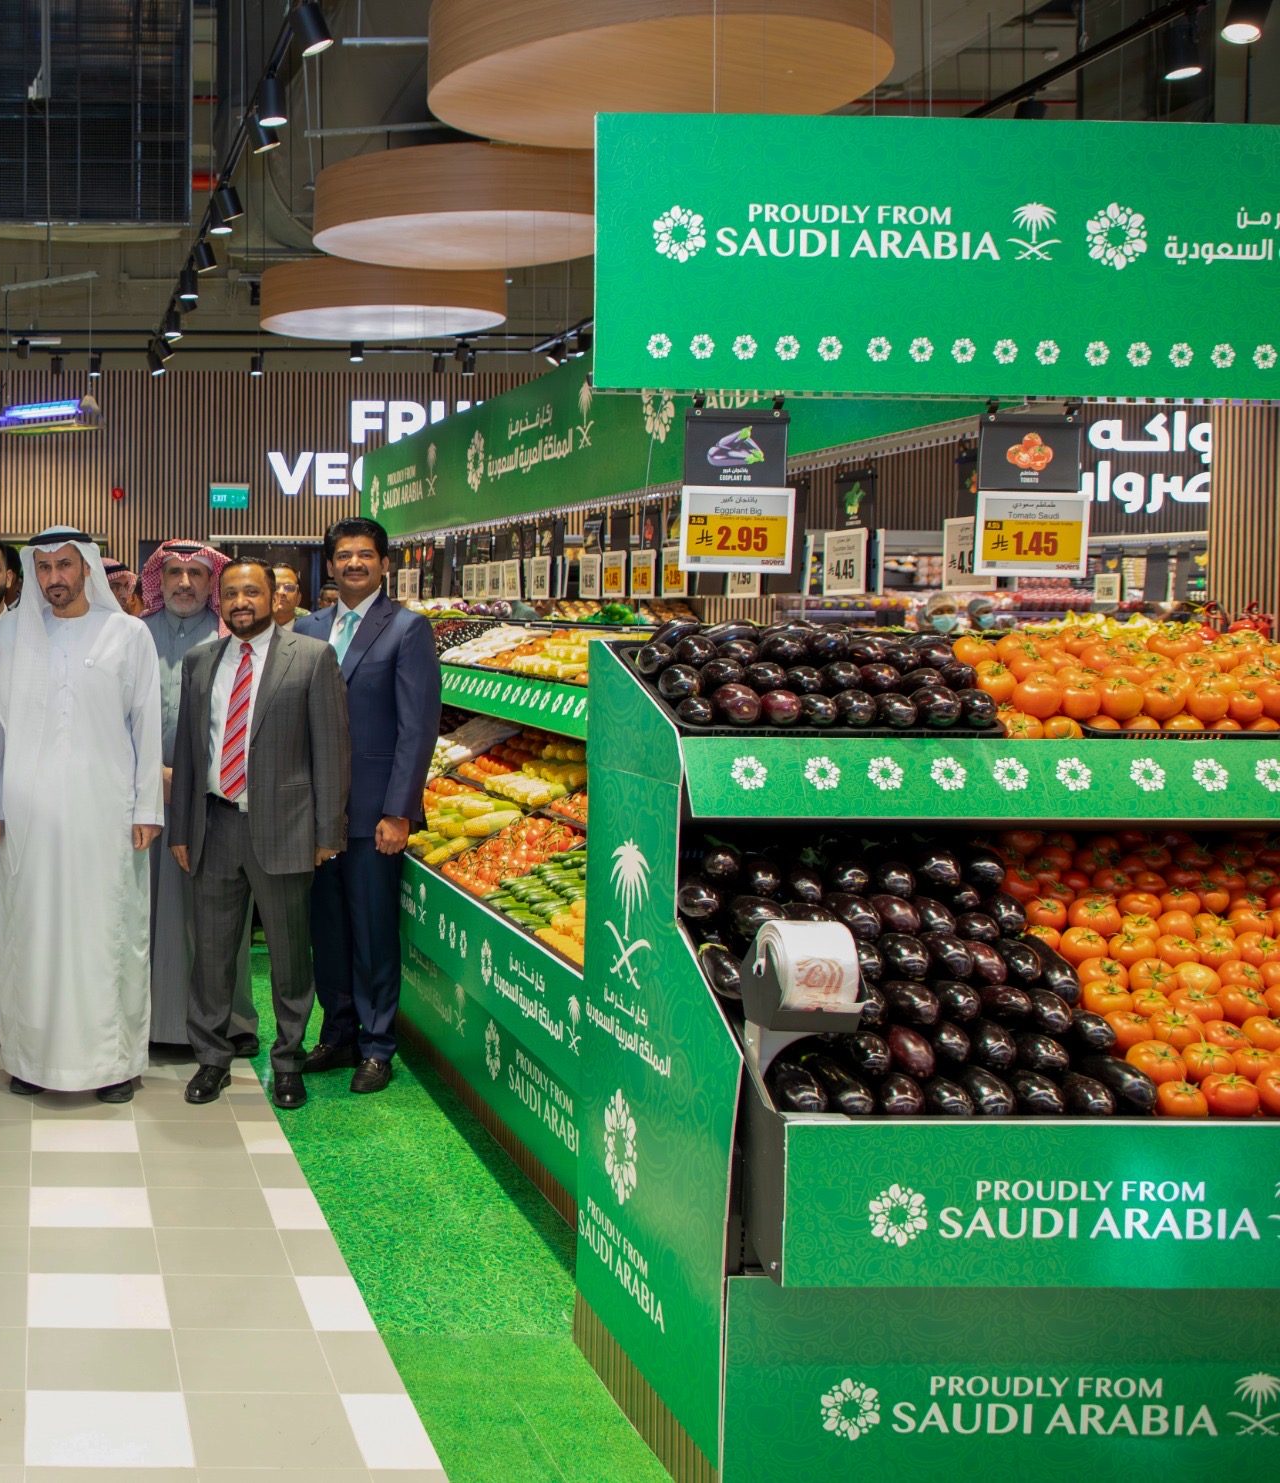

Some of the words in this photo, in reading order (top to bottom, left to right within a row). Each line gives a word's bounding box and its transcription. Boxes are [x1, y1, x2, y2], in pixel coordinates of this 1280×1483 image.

[748, 203, 870, 224] PROUDLY
[877, 205, 952, 225] FROM
[1237, 206, 1271, 229] من
[715, 227, 839, 258] SAUDI
[850, 229, 1001, 261] ARABIA
[1164, 235, 1273, 265] السعودية
[212, 494, 227, 502] EXIT
[383, 487, 401, 511] SAUDI
[401, 479, 423, 505] ARABIA
[714, 506, 748, 516] Eggplant
[750, 507, 762, 516] Big
[1008, 511, 1036, 519] Tomato
[1038, 511, 1060, 520] Saudi
[716, 525, 768, 552] 2.95
[1012, 531, 1058, 556] 1.45
[835, 559, 854, 579] 4.45
[585, 995, 614, 1036] السعودية
[615, 1018, 638, 1054] العربية
[639, 1036, 671, 1078] المملكة
[516, 1048, 549, 1093] PROUDLY
[550, 1080, 573, 1118] FROM
[508, 1064, 541, 1118] SAUDI
[543, 1099, 579, 1158] ARABI
[975, 1180, 1113, 1201] PROUDLY
[1122, 1181, 1206, 1202] FROM
[587, 1195, 622, 1249] PROUDLY
[623, 1237, 648, 1280] FROM
[938, 1206, 1078, 1239] SAUDI
[1090, 1208, 1261, 1240] ARABIA
[578, 1209, 613, 1272] SAUDI
[615, 1254, 665, 1334] ARABIA
[929, 1376, 1069, 1398] PROUDLY
[1077, 1377, 1163, 1399] FROM
[891, 1401, 1032, 1435] SAUDI
[1045, 1404, 1219, 1437] ARABIA
